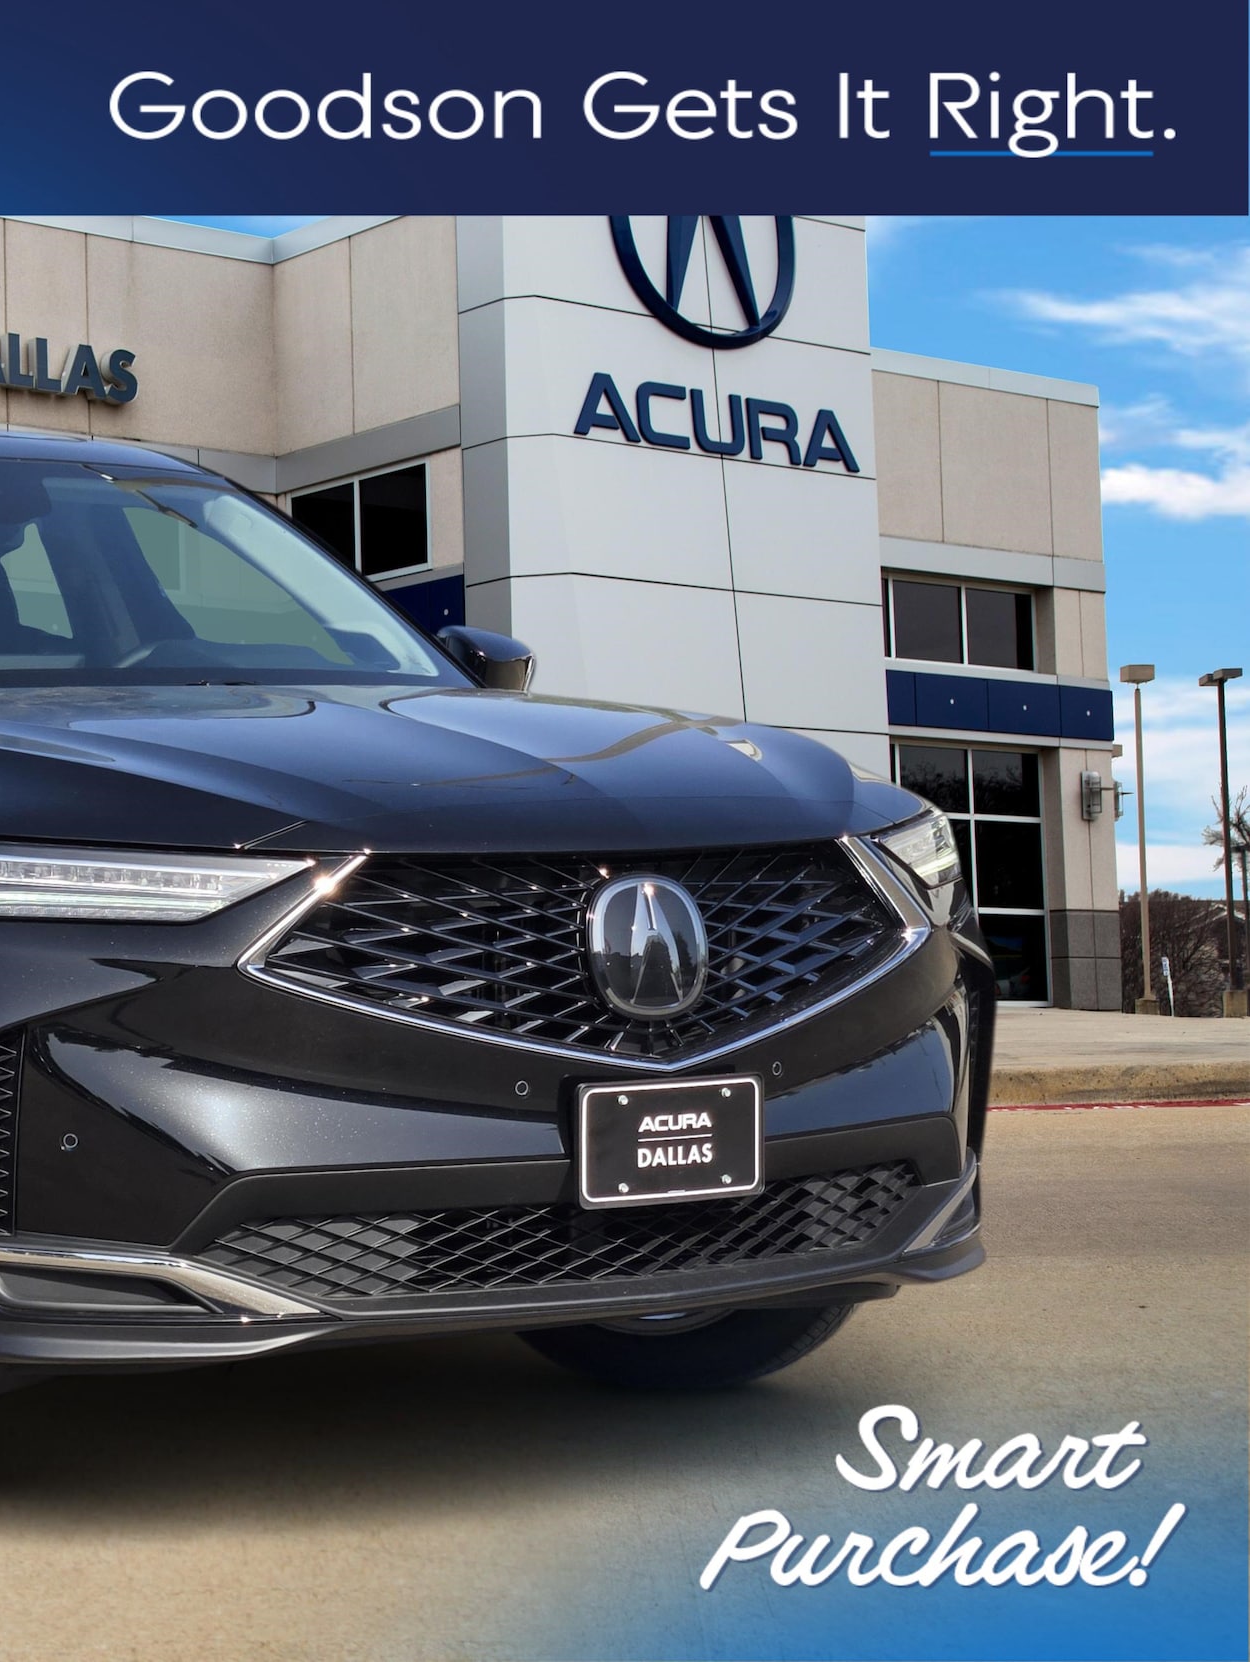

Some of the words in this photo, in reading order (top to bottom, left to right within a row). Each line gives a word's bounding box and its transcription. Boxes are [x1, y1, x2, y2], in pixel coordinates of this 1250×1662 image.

[573, 372, 860, 473] ACURA
[638, 1112, 713, 1132] ACURA
[637, 1143, 713, 1168] DALLAS
